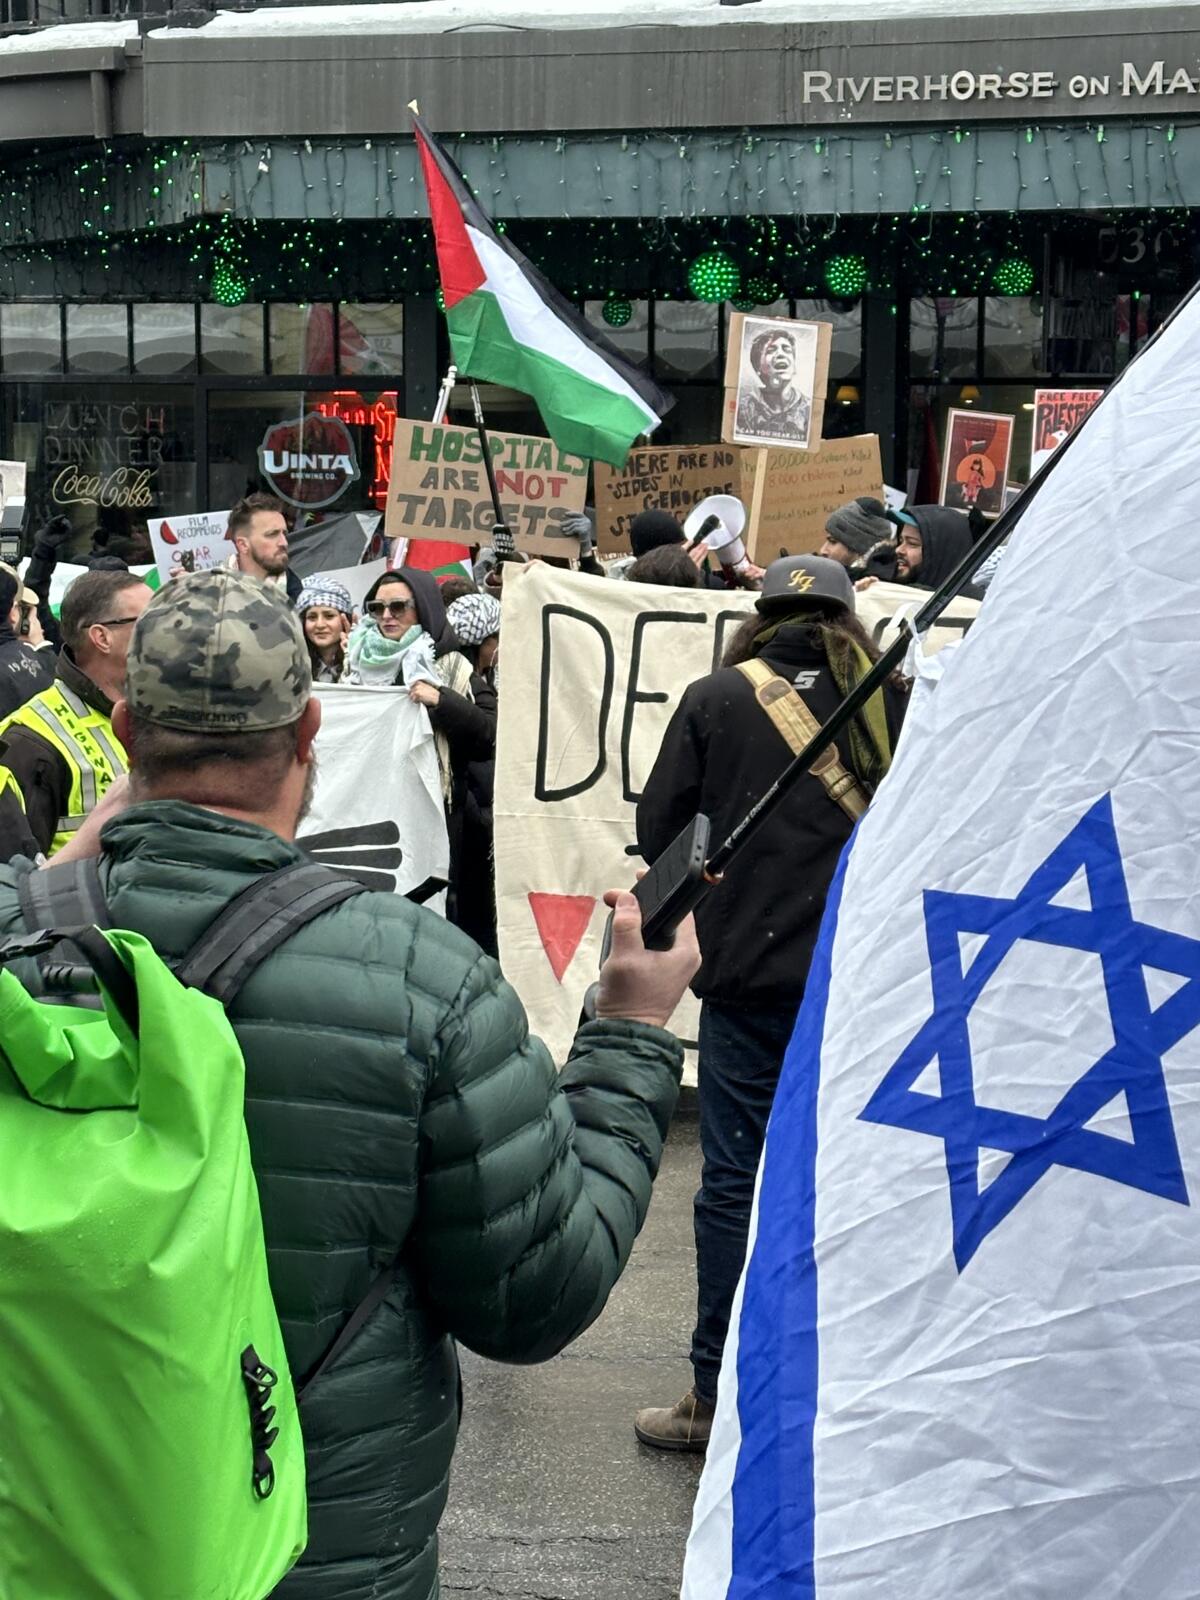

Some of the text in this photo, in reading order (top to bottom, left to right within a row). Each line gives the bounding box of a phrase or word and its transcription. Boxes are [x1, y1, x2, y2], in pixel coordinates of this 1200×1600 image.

[802, 61, 1200, 103] RIVERHORSE ON MA
[263, 450, 354, 475] UINTA
[409, 425, 588, 477] HOSPITALS
[610, 451, 670, 478] HERE
[677, 452, 708, 471] ARE
[713, 450, 734, 468] NO
[420, 467, 568, 501] ARE NOT
[397, 493, 571, 539] TARGETS
[171, 546, 212, 563] OAR
